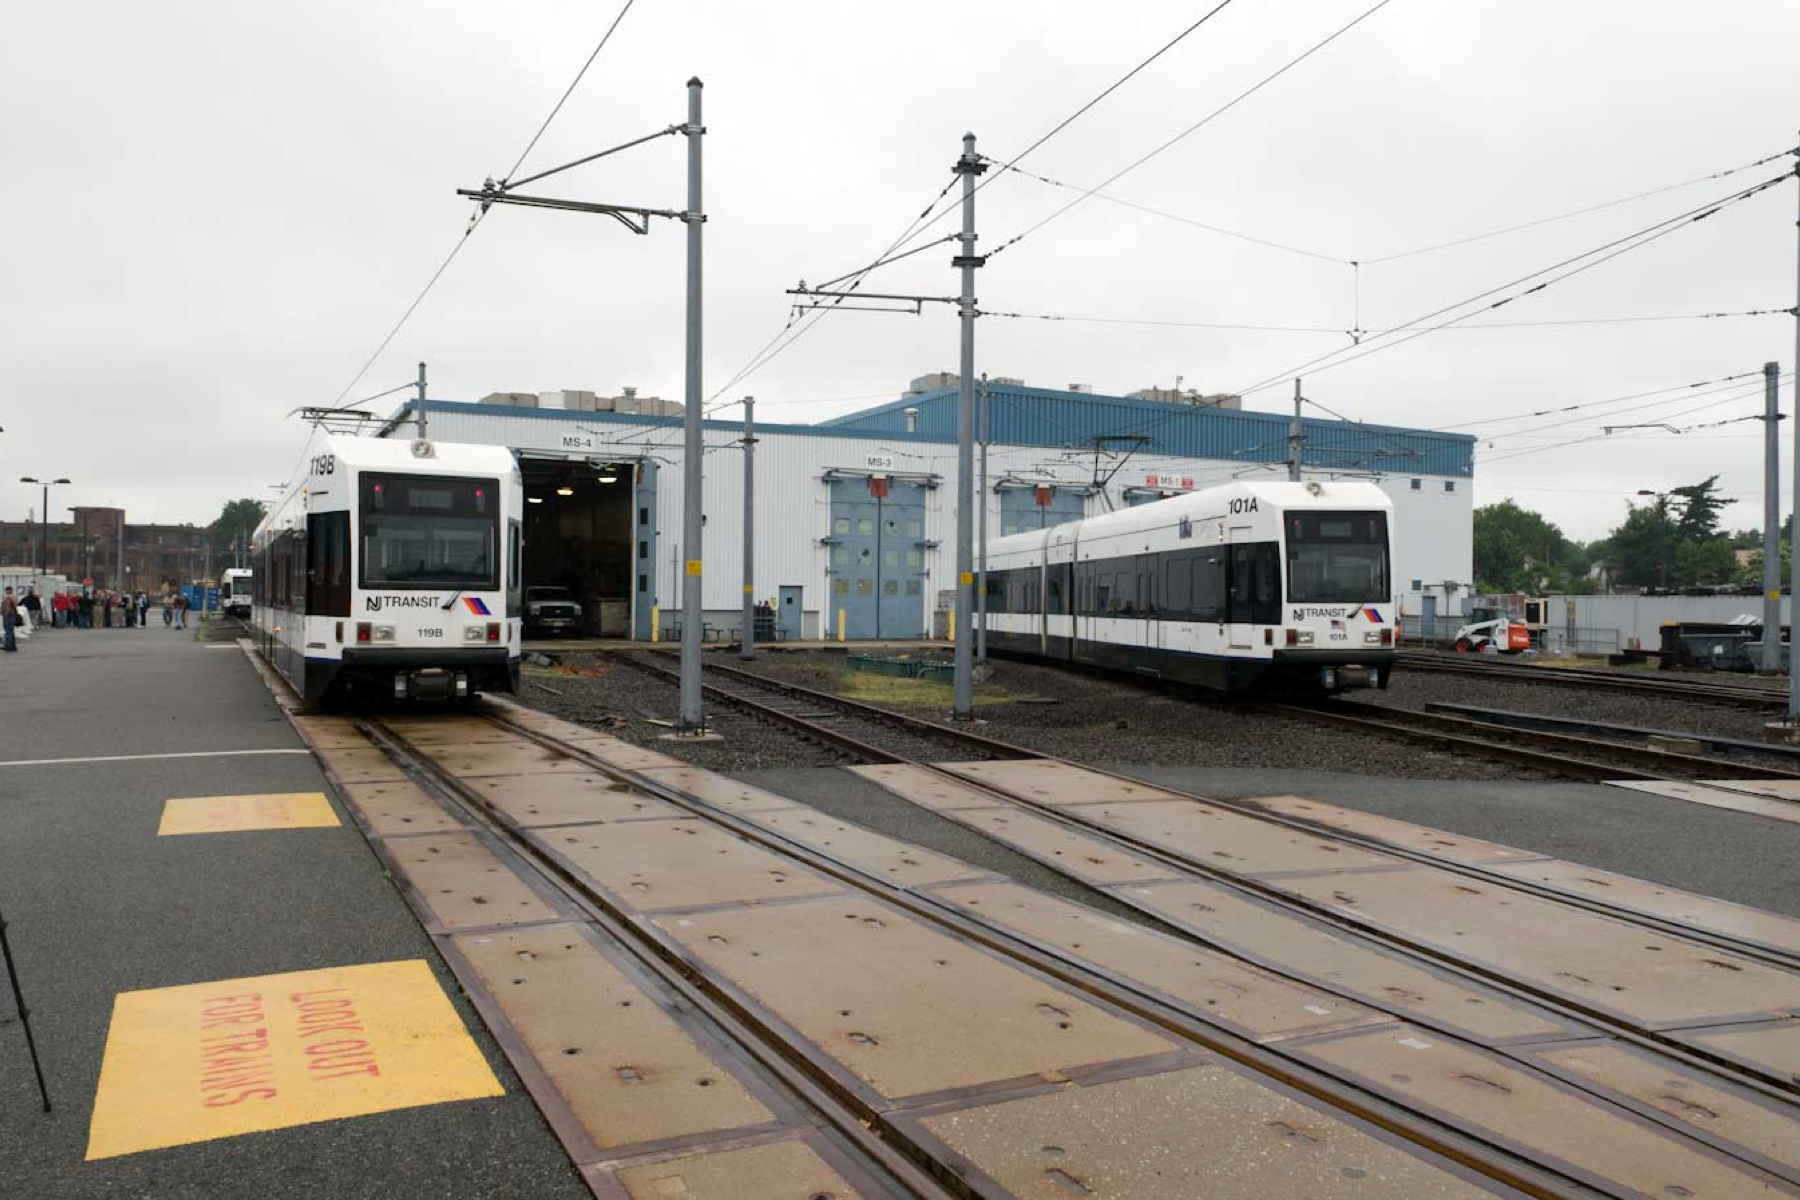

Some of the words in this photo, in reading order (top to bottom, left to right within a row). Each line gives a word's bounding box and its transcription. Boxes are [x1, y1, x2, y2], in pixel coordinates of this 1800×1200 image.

[562, 437, 592, 448] MS-4
[310, 454, 335, 476] 119B
[1228, 496, 1259, 514] 101A
[366, 595, 382, 612] NJ
[385, 596, 441, 608] TRANSIT
[1304, 608, 1346, 617] TRANSIT
[418, 628, 443, 639] 119B
[201, 993, 264, 1029] FOR
[290, 988, 364, 1037] LOOK
[201, 1028, 277, 1107] TRAINS
[304, 1039, 380, 1080] OUT
